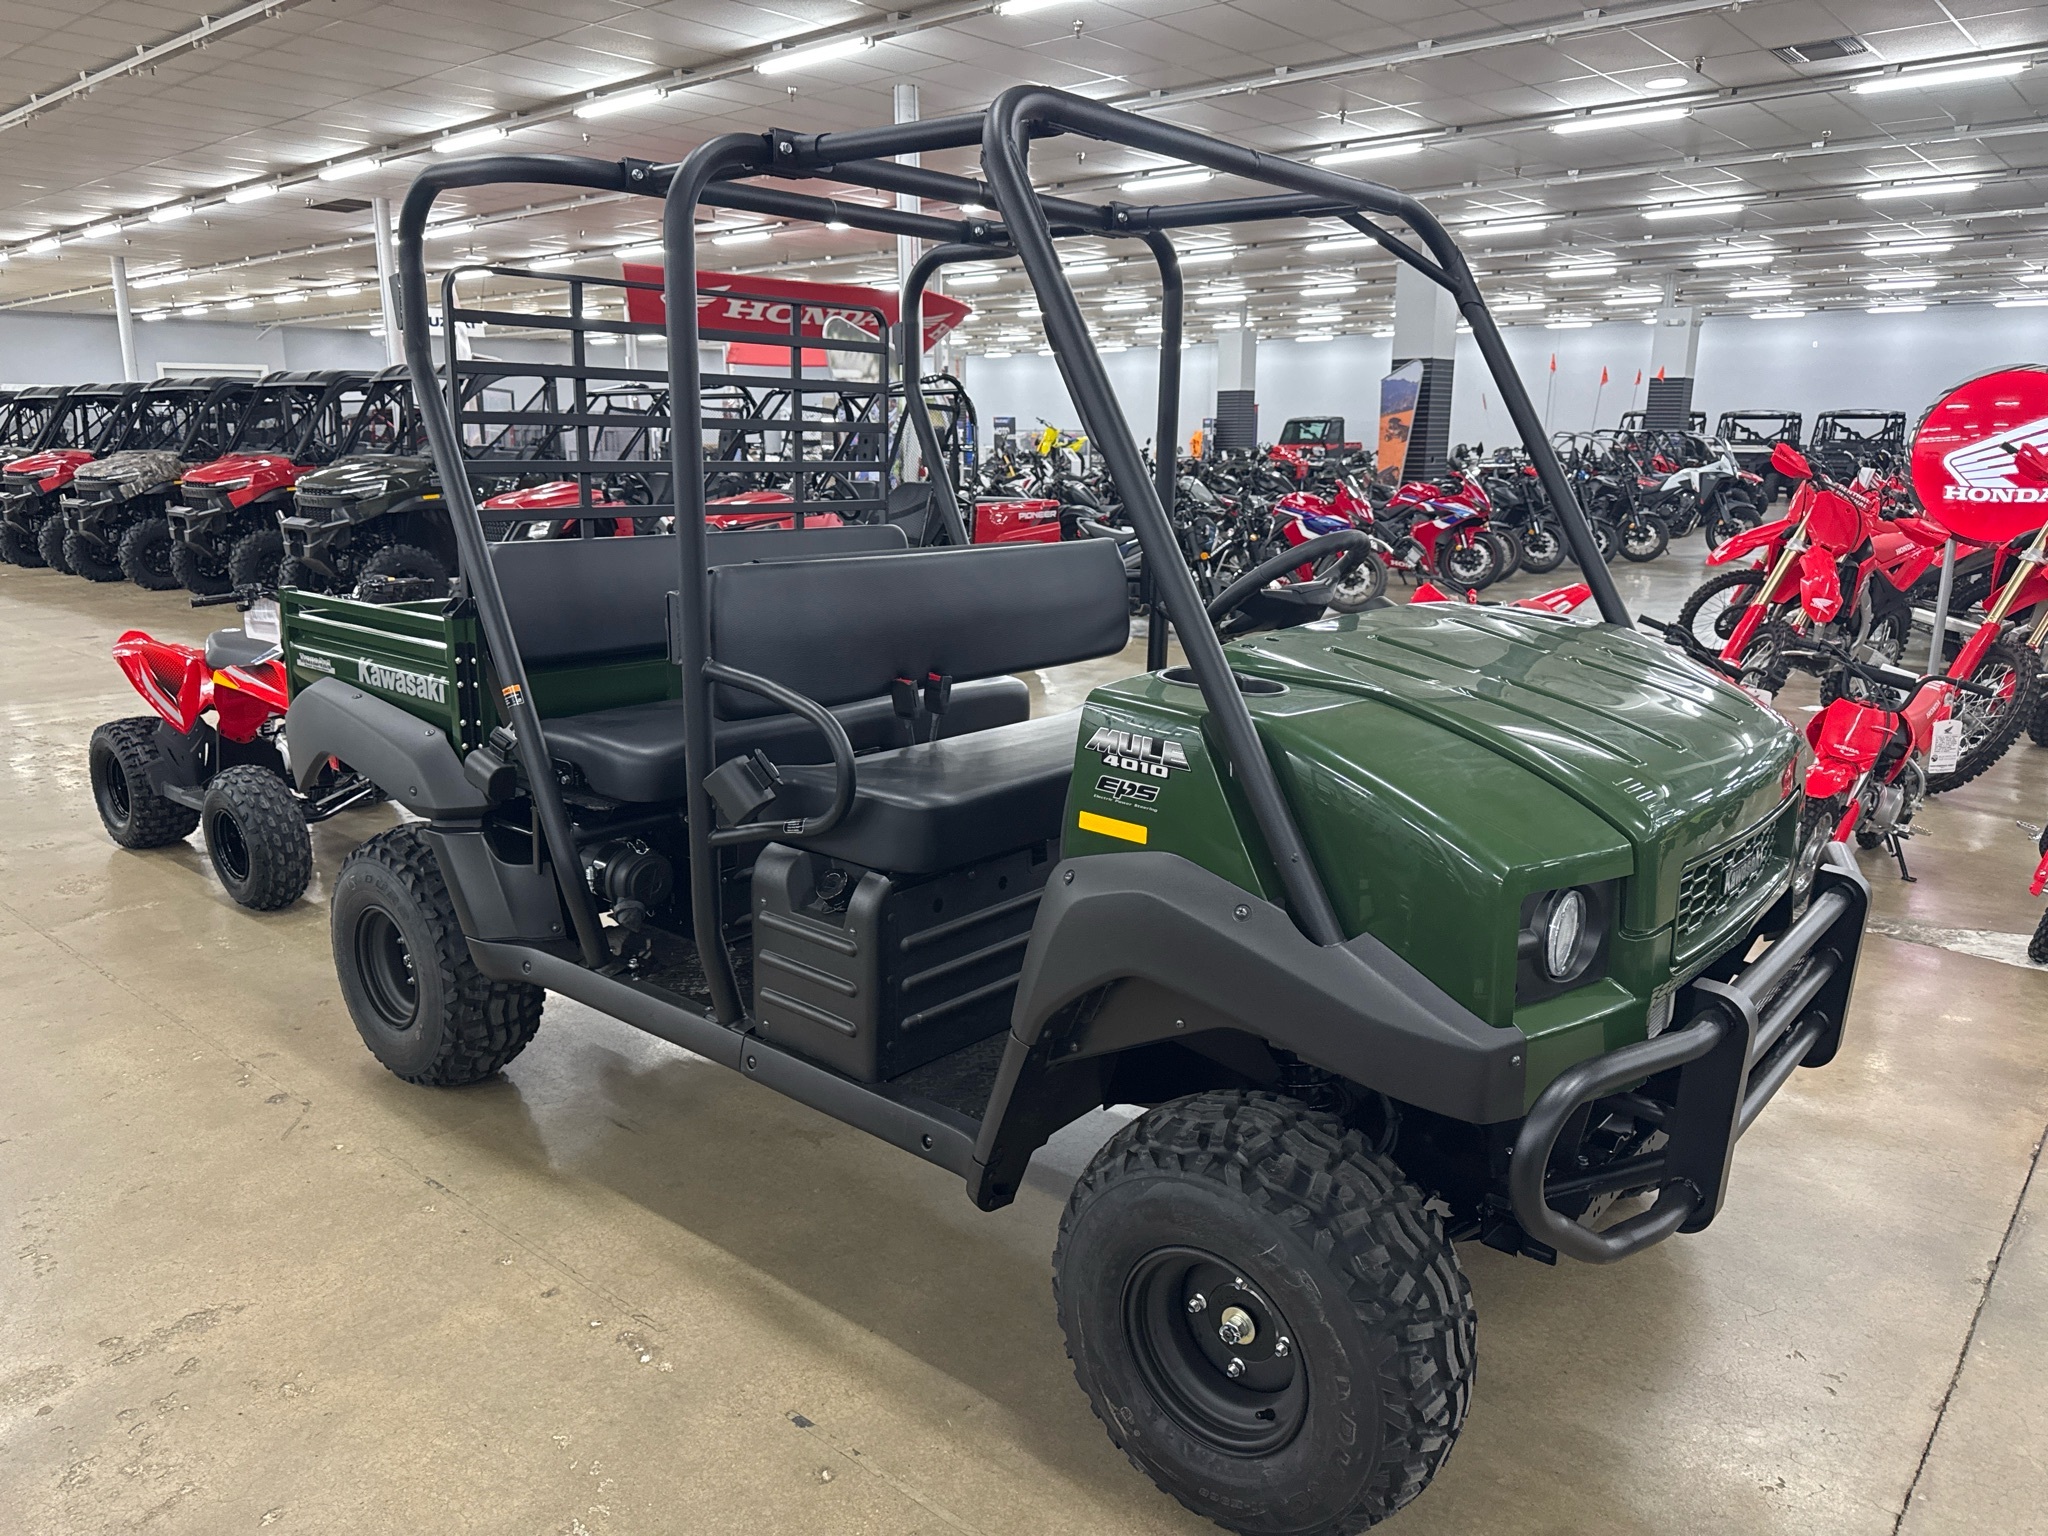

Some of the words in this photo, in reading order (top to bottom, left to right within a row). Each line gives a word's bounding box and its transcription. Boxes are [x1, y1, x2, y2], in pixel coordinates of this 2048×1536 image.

[722, 299, 879, 327] HONDA
[1018, 510, 1057, 520] PIONEER
[357, 656, 447, 705] Kawasaki
[1085, 727, 1191, 771] MULE
[1102, 754, 1170, 779] 4010
